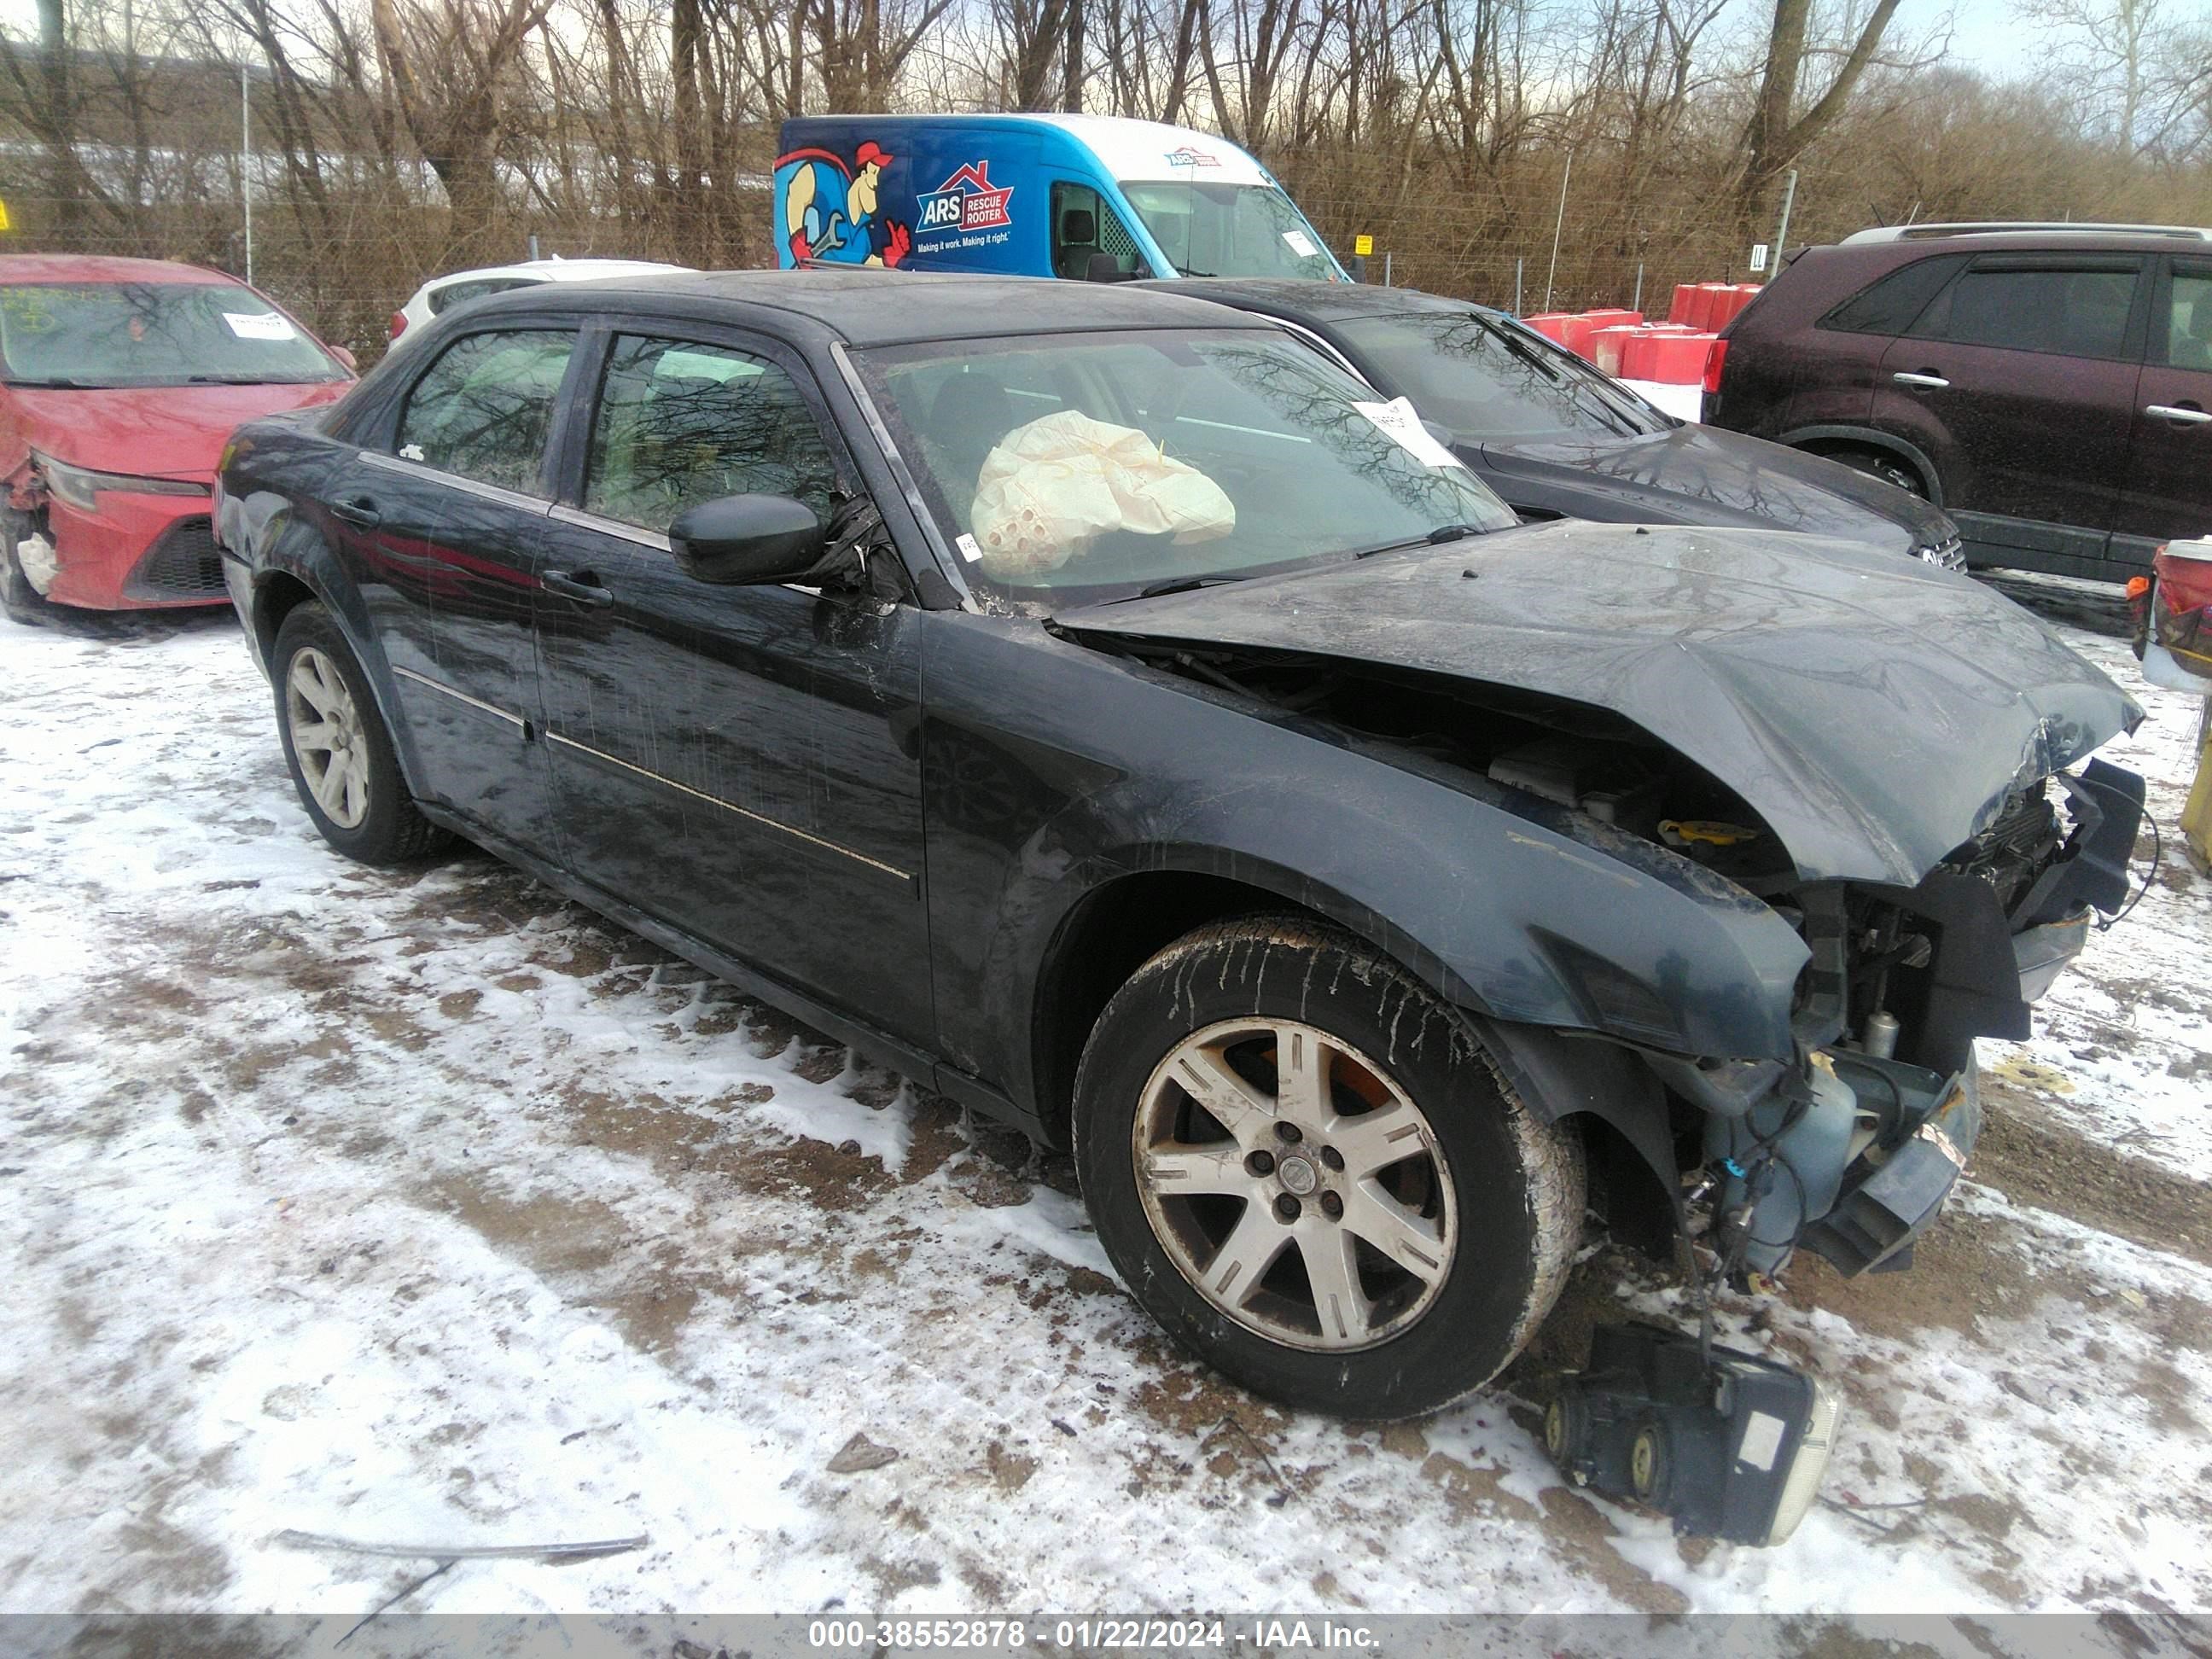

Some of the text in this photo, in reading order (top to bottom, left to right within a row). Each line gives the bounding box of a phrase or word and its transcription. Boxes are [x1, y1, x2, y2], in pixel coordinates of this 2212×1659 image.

[923, 195, 961, 224] ARS
[968, 195, 1001, 212] RESCUE
[967, 209, 1001, 224] ROOTER
[918, 243, 939, 253] Making
[940, 242, 945, 250] it
[945, 238, 962, 249] work.
[963, 236, 985, 247] Making
[986, 234, 991, 244] it
